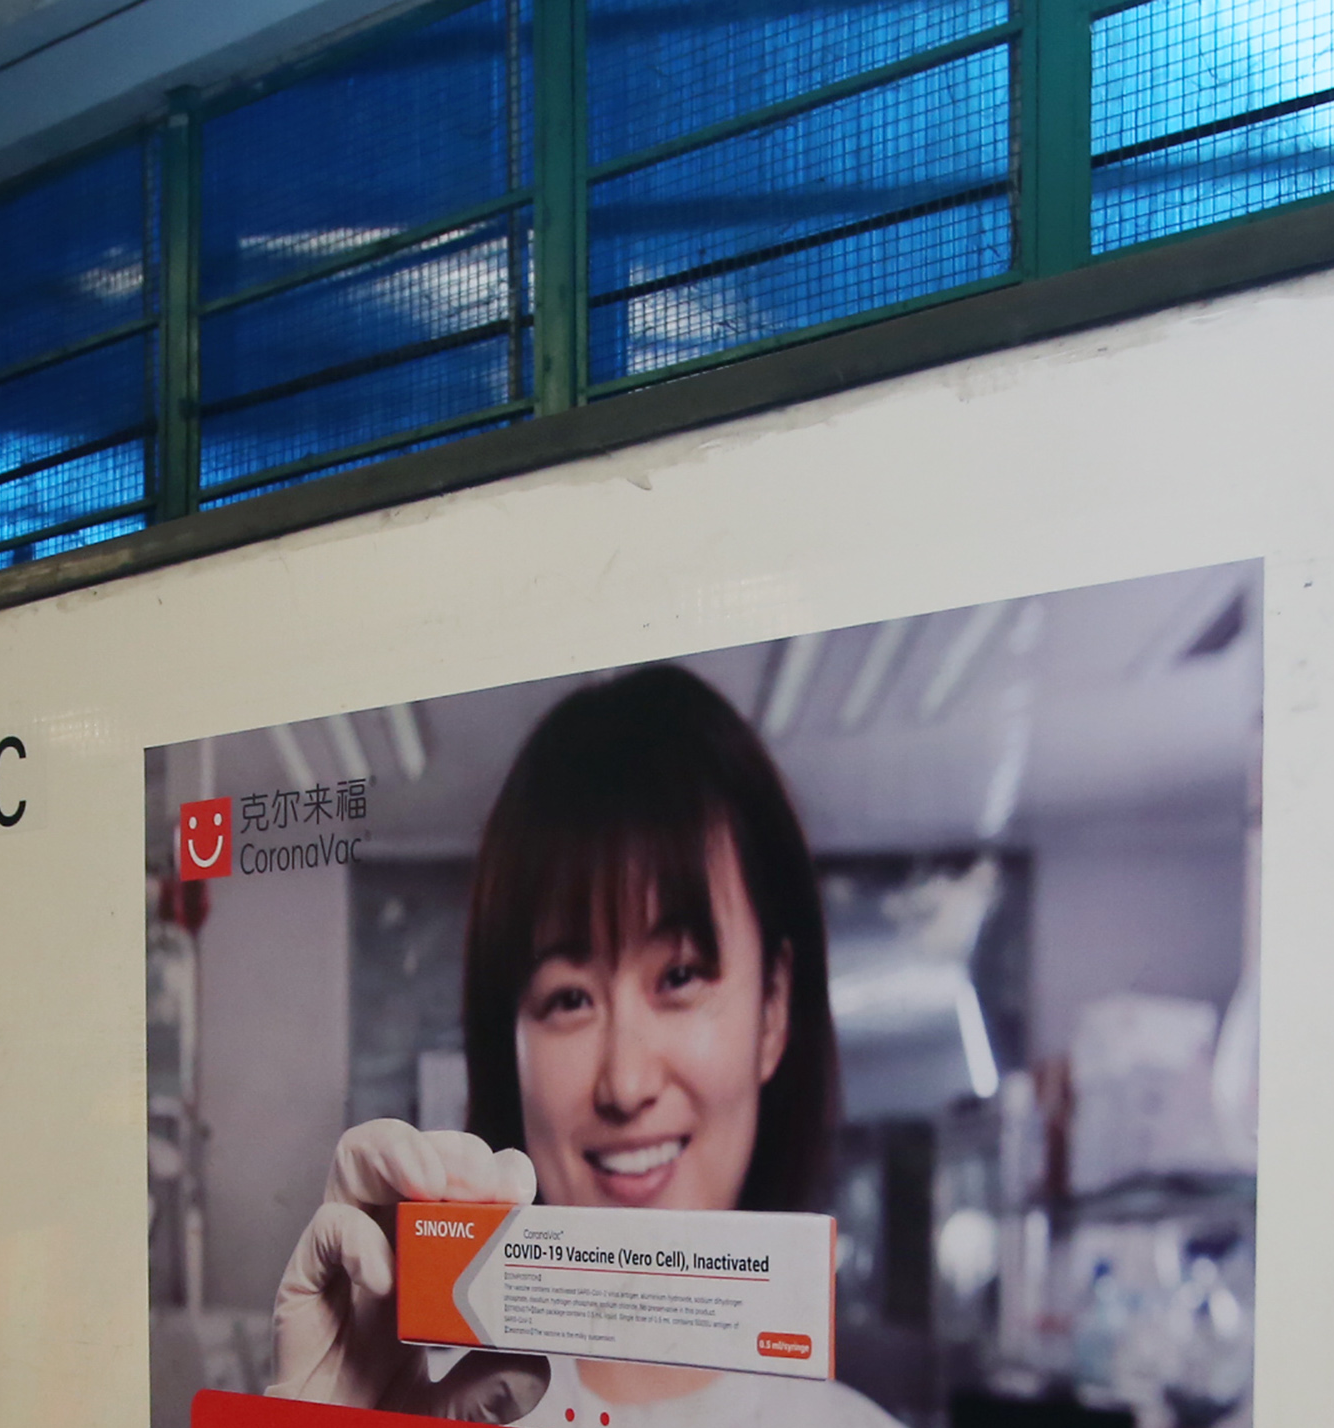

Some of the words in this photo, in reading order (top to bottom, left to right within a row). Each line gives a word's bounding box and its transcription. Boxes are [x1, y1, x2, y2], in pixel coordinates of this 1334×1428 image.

[240, 778, 367, 834] 克尔来福
[240, 832, 363, 875] CoronaVac
[415, 1219, 475, 1240] SINOVAC
[504, 1243, 564, 1261] COVID-19
[566, 1246, 615, 1265] Vaccine
[618, 1248, 653, 1268] (Vero
[655, 1250, 689, 1272] Cell),
[693, 1253, 770, 1273] Inactivated
